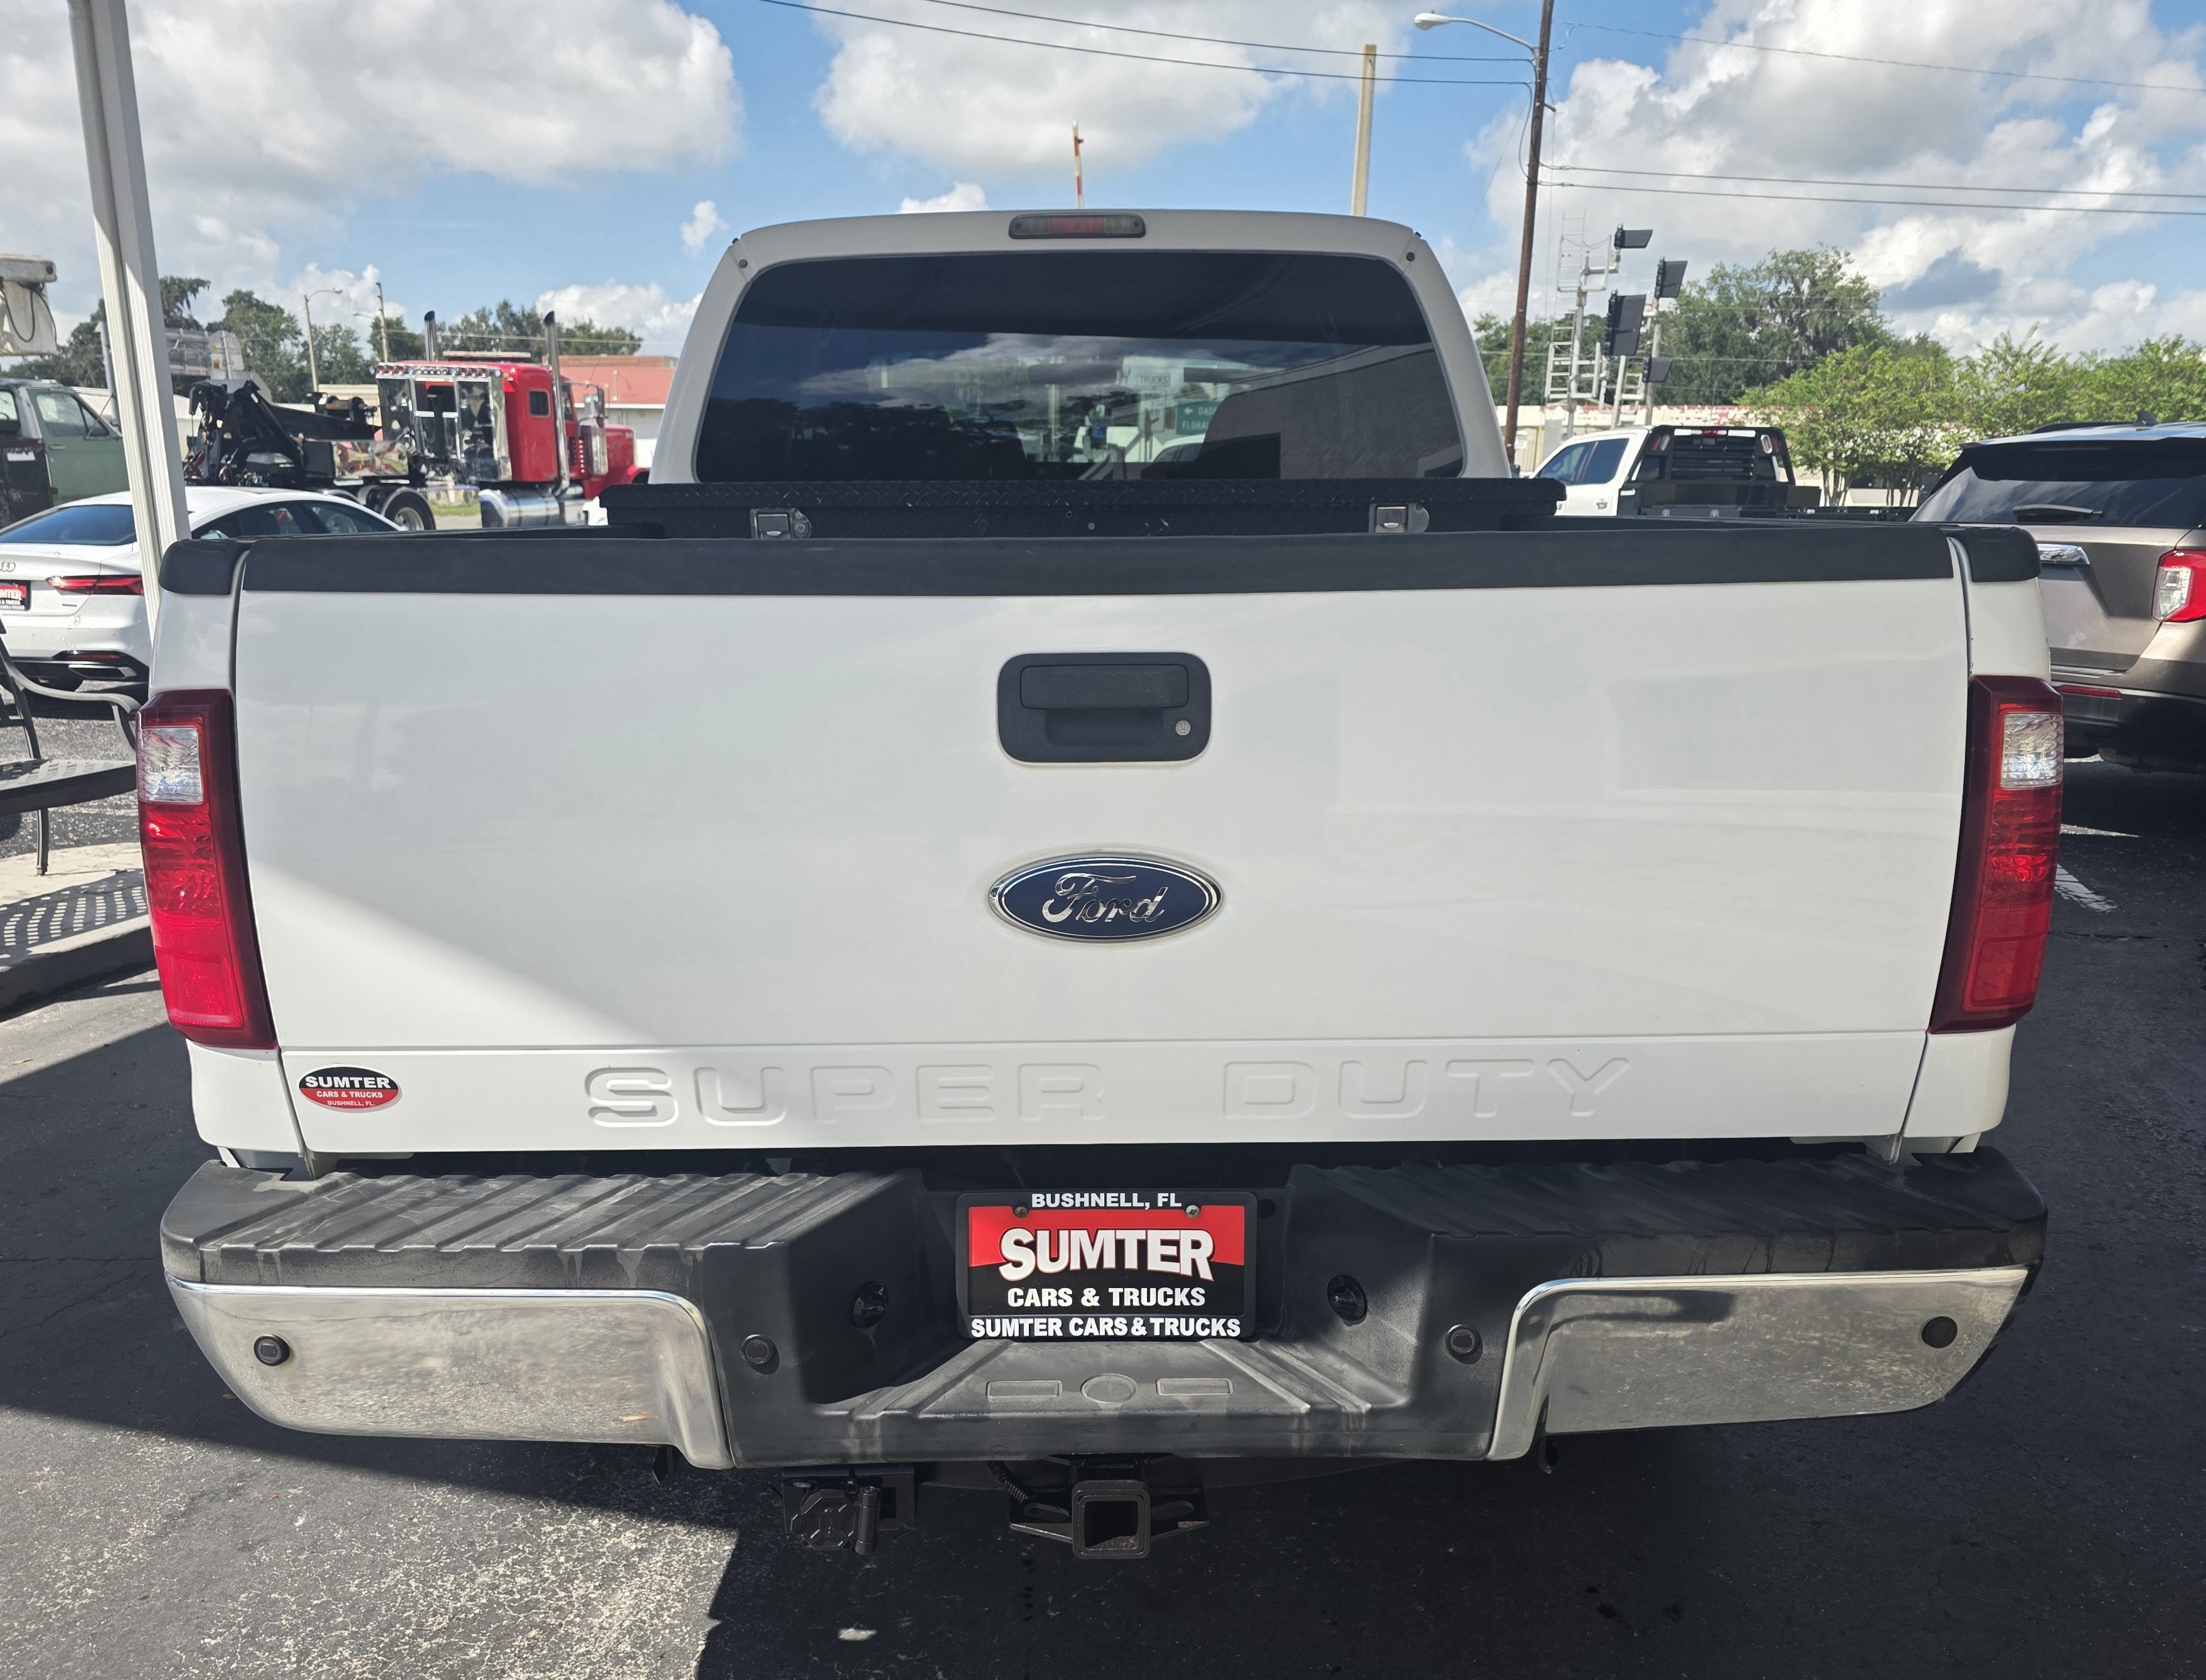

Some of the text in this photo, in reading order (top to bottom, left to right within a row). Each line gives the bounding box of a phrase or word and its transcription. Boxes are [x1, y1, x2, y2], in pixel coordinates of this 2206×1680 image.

[1042, 873, 1168, 923] Ford
[305, 1075, 392, 1088] SUMTER
[584, 1058, 1630, 1127] SUPER DUTY
[1031, 1193, 1182, 1210] BUSHNELL, FL
[998, 1228, 1215, 1282] SUMTER
[1007, 1287, 1206, 1307] CARS & TRUCKS
[971, 1317, 1241, 1337] SUMTER CARS & TRUCKS
